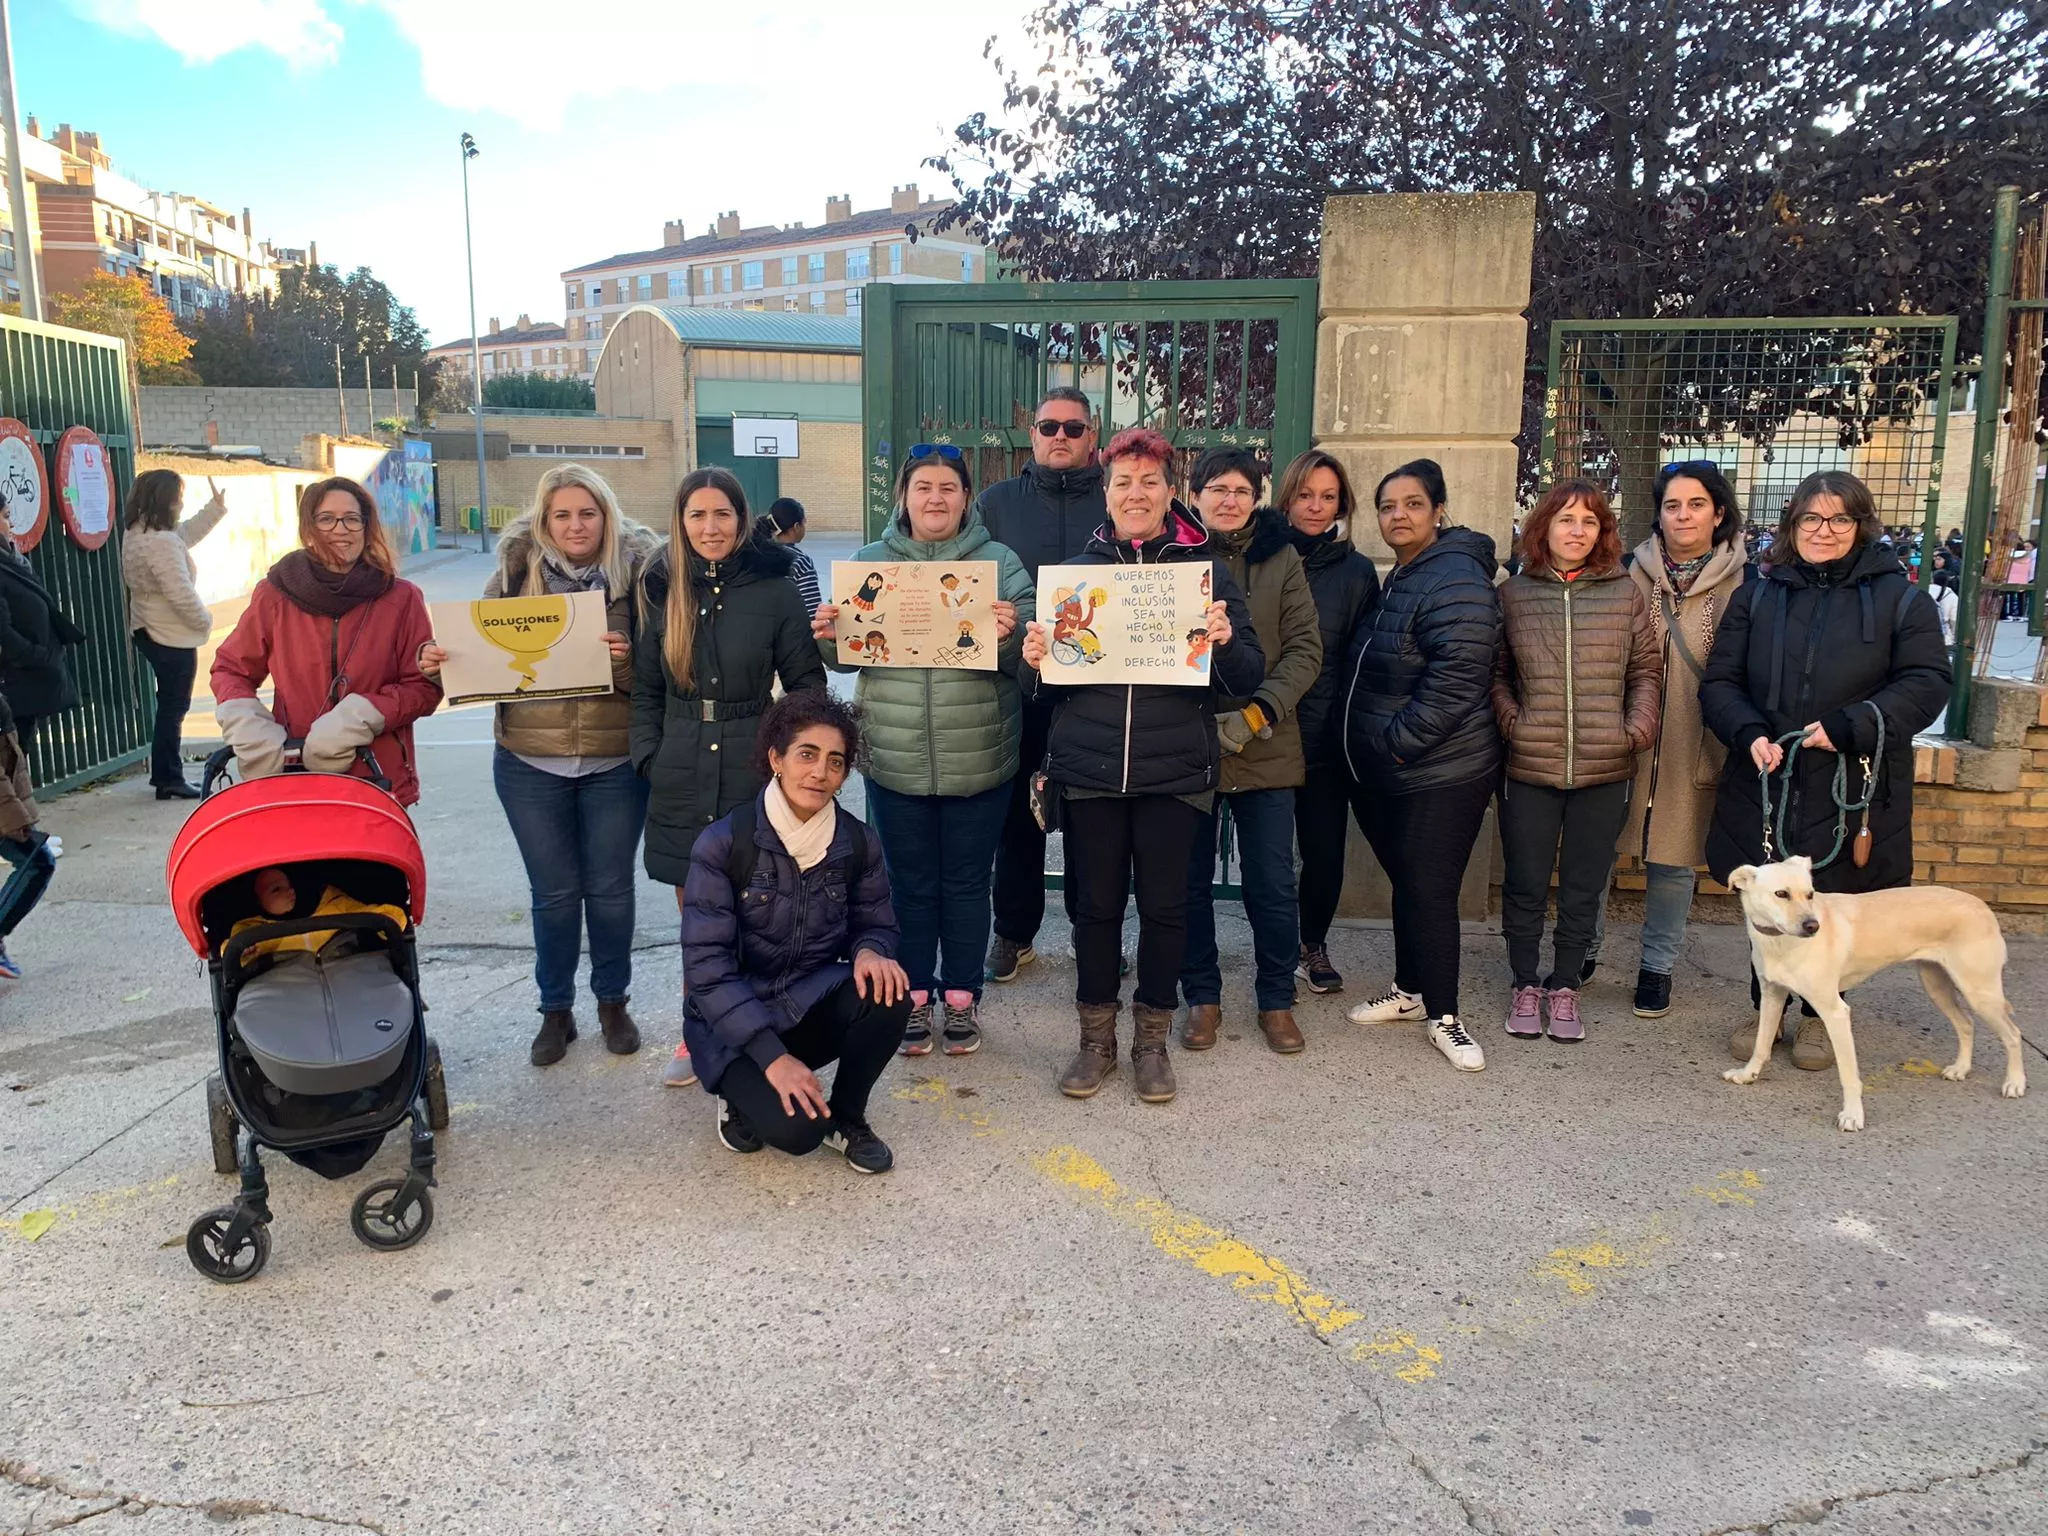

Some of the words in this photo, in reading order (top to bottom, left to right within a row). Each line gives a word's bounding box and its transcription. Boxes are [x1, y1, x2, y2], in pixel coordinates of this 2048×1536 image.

[1114, 569, 1175, 581] QUEREMOS
[1131, 584, 1154, 593] QUE
[1160, 583, 1175, 593] LA
[1121, 593, 1175, 606] INCLUSIÓN
[1133, 609, 1156, 619] SEA
[1162, 608, 1175, 618] UN
[483, 614, 560, 627] SOLUCIONES
[1126, 622, 1162, 631] HECHO
[1168, 620, 1175, 630] Y
[514, 625, 531, 633] YA
[1130, 633, 1144, 643] NO
[1150, 633, 1176, 643] SOLO
[1162, 645, 1175, 654] UN
[1125, 657, 1176, 667] DERECHO
